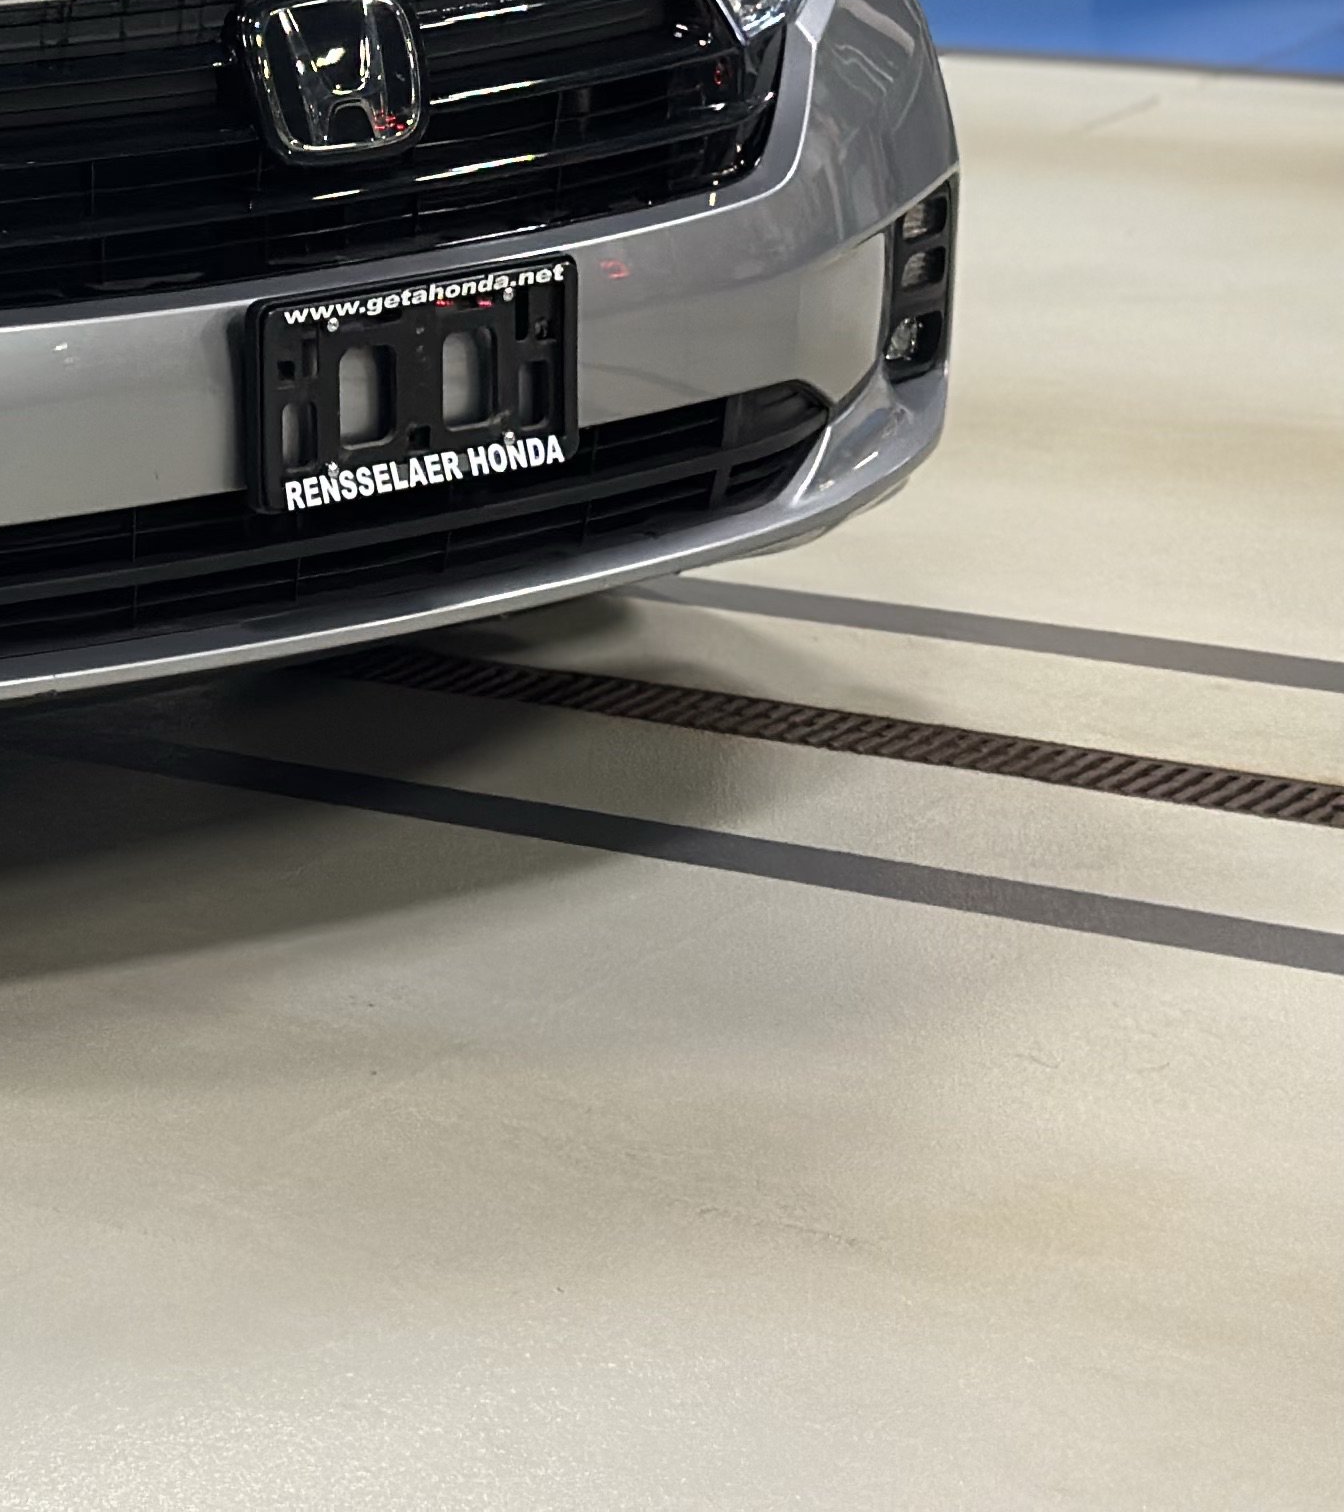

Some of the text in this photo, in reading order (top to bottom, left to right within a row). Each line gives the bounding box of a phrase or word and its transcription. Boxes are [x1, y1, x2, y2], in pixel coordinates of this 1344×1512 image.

[283, 264, 564, 325] www.getahonda.net
[284, 434, 565, 511] RENSSELAER HONDA
